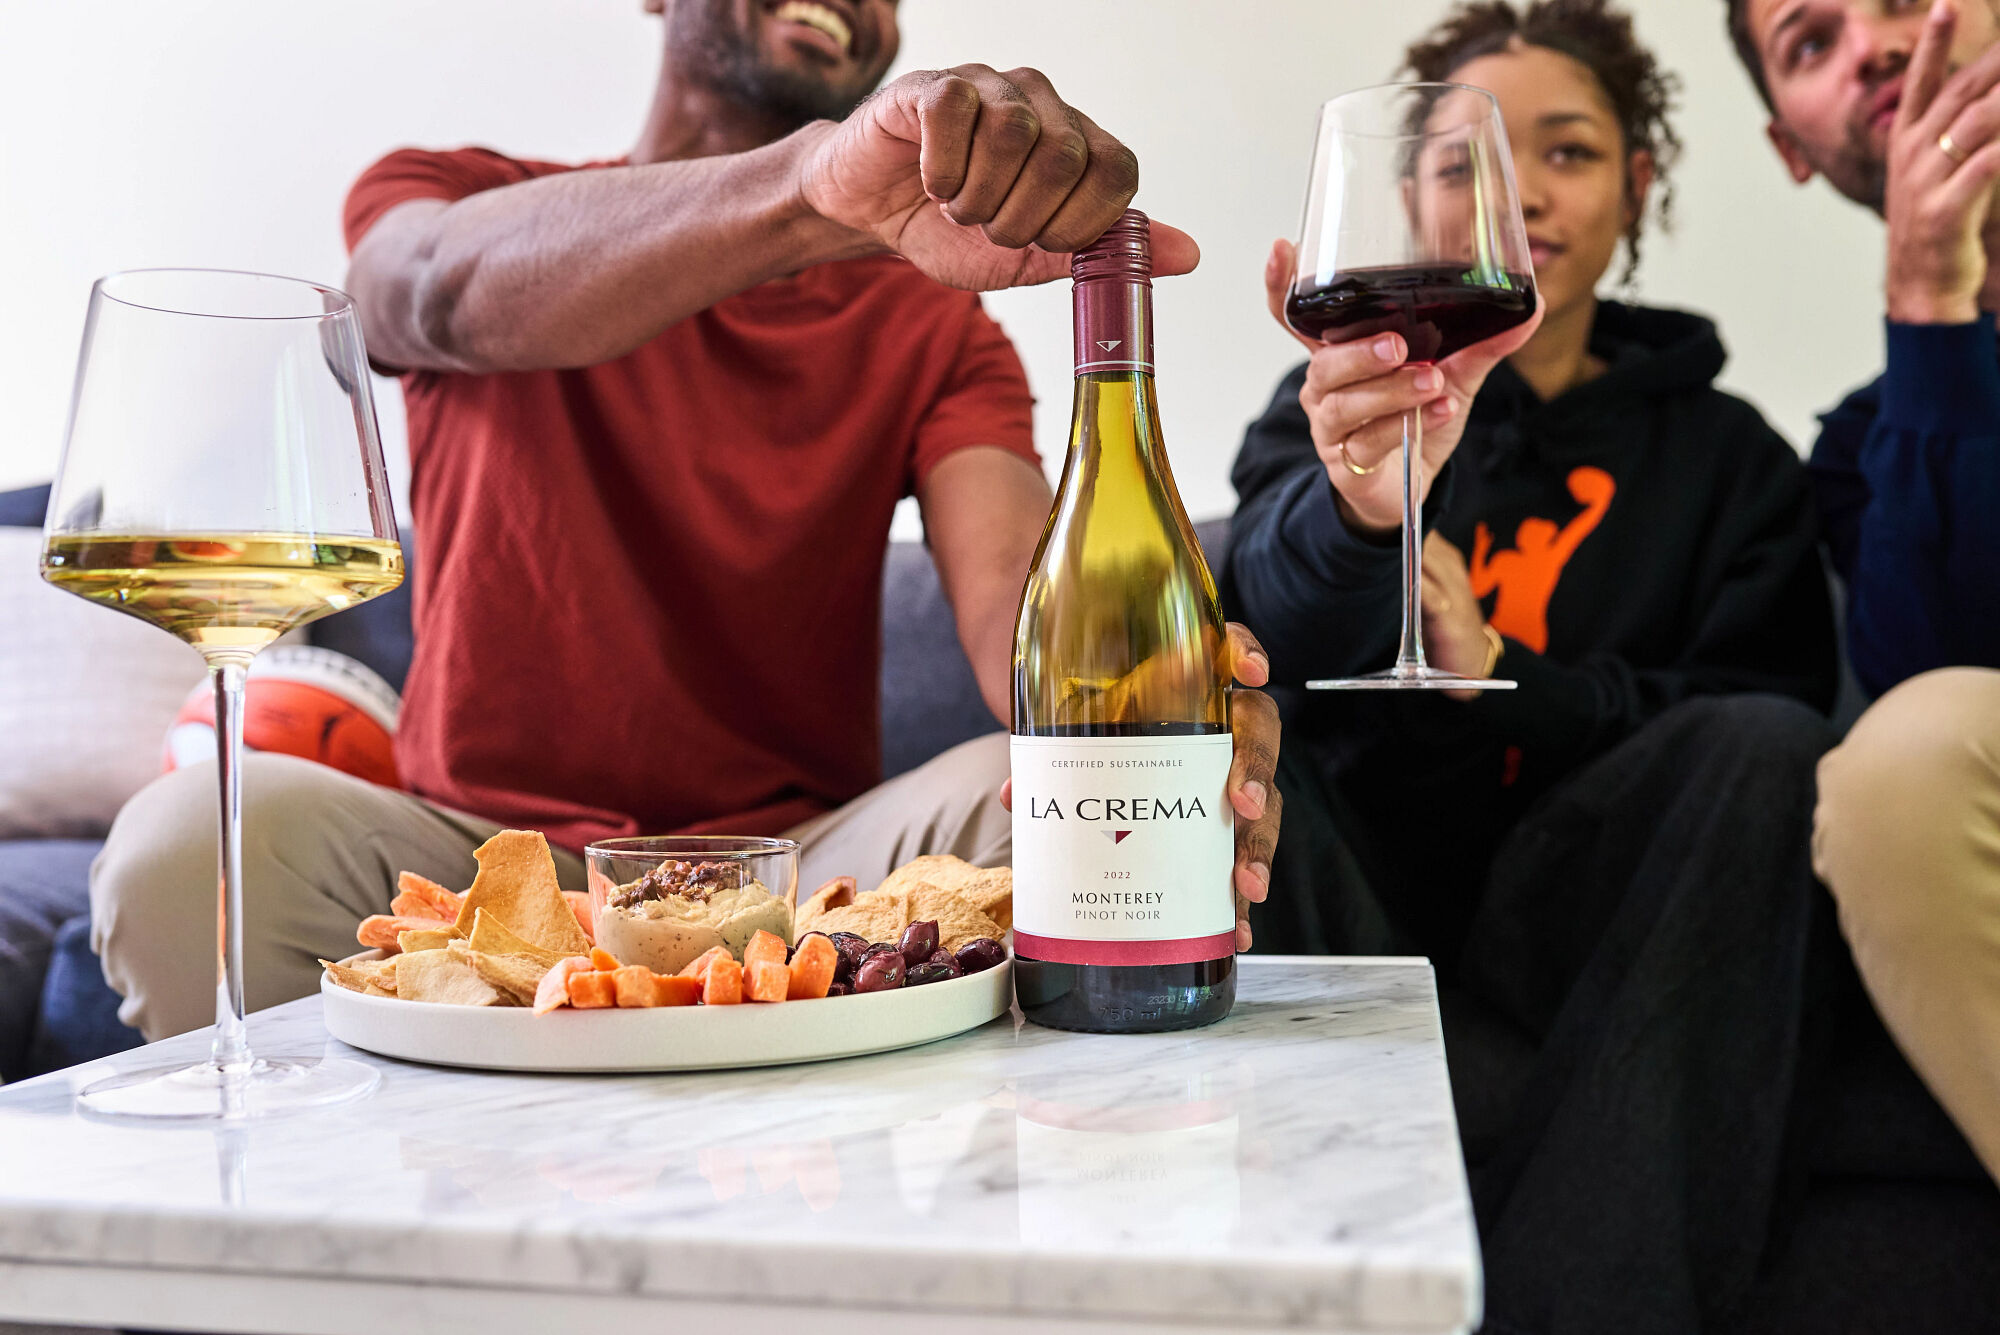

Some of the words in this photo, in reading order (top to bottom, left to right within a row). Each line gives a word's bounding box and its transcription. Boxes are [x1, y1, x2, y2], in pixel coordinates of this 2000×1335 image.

[1051, 760, 1104, 768] CERTIFIED
[1110, 759, 1183, 768] SUSTAINABLE
[1031, 796, 1064, 820] LA
[1075, 796, 1207, 821] CREMA
[1103, 871, 1131, 879] 2022
[1072, 892, 1164, 905] MONTEREY
[1075, 910, 1118, 920] PINOT
[1125, 910, 1161, 920] NOIR
[1097, 1007, 1134, 1022] 750
